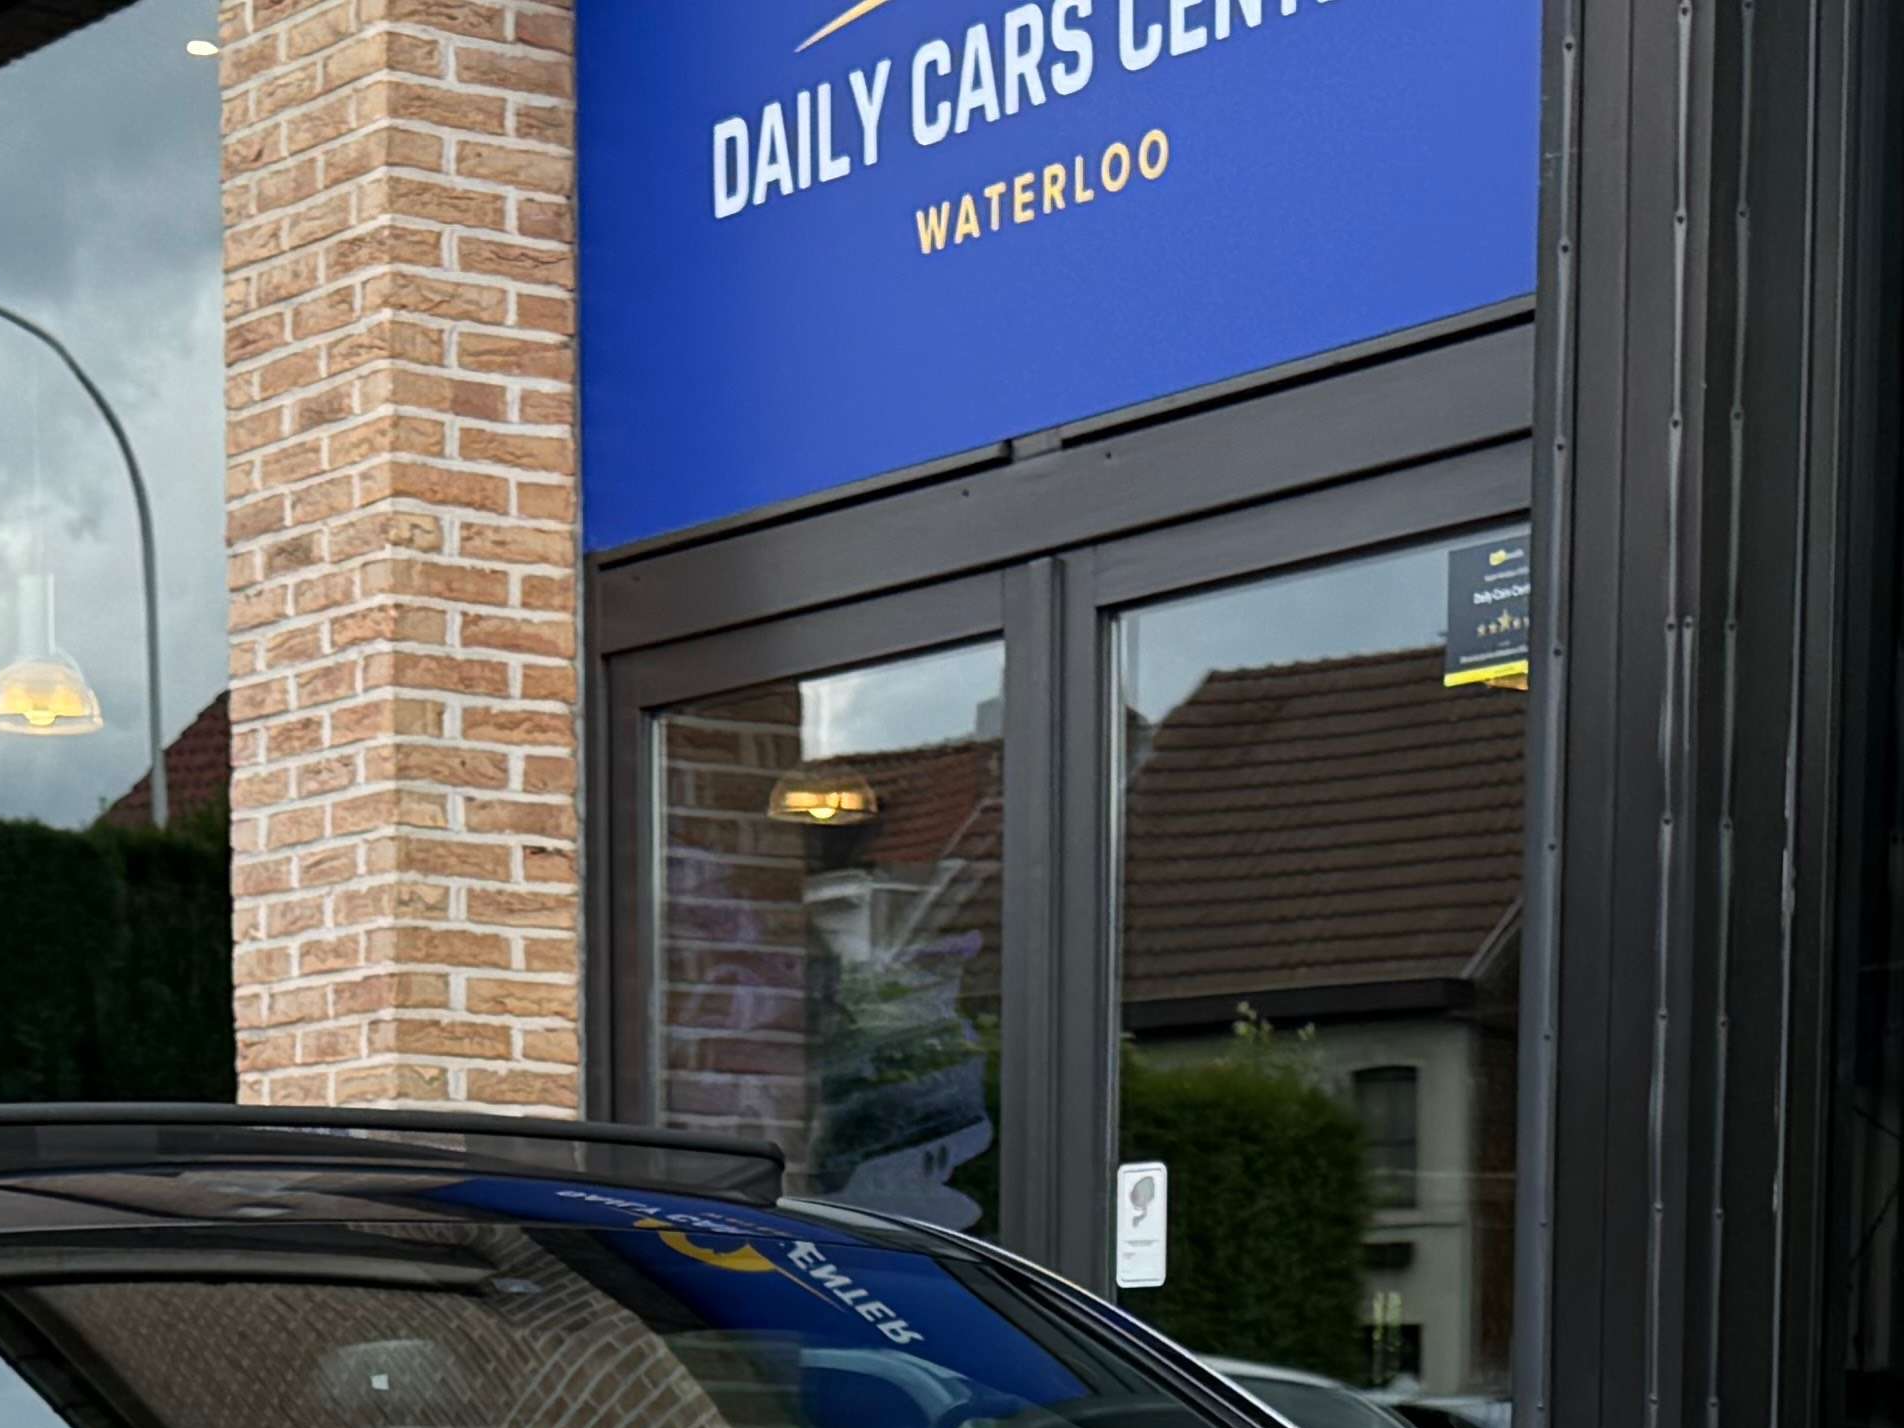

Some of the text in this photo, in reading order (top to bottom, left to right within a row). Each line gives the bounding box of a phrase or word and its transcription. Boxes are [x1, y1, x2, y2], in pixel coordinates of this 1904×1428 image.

[713, 58, 892, 219] DAILY
[911, 0, 1094, 146] CARS
[916, 129, 1170, 254] WATERLOO
